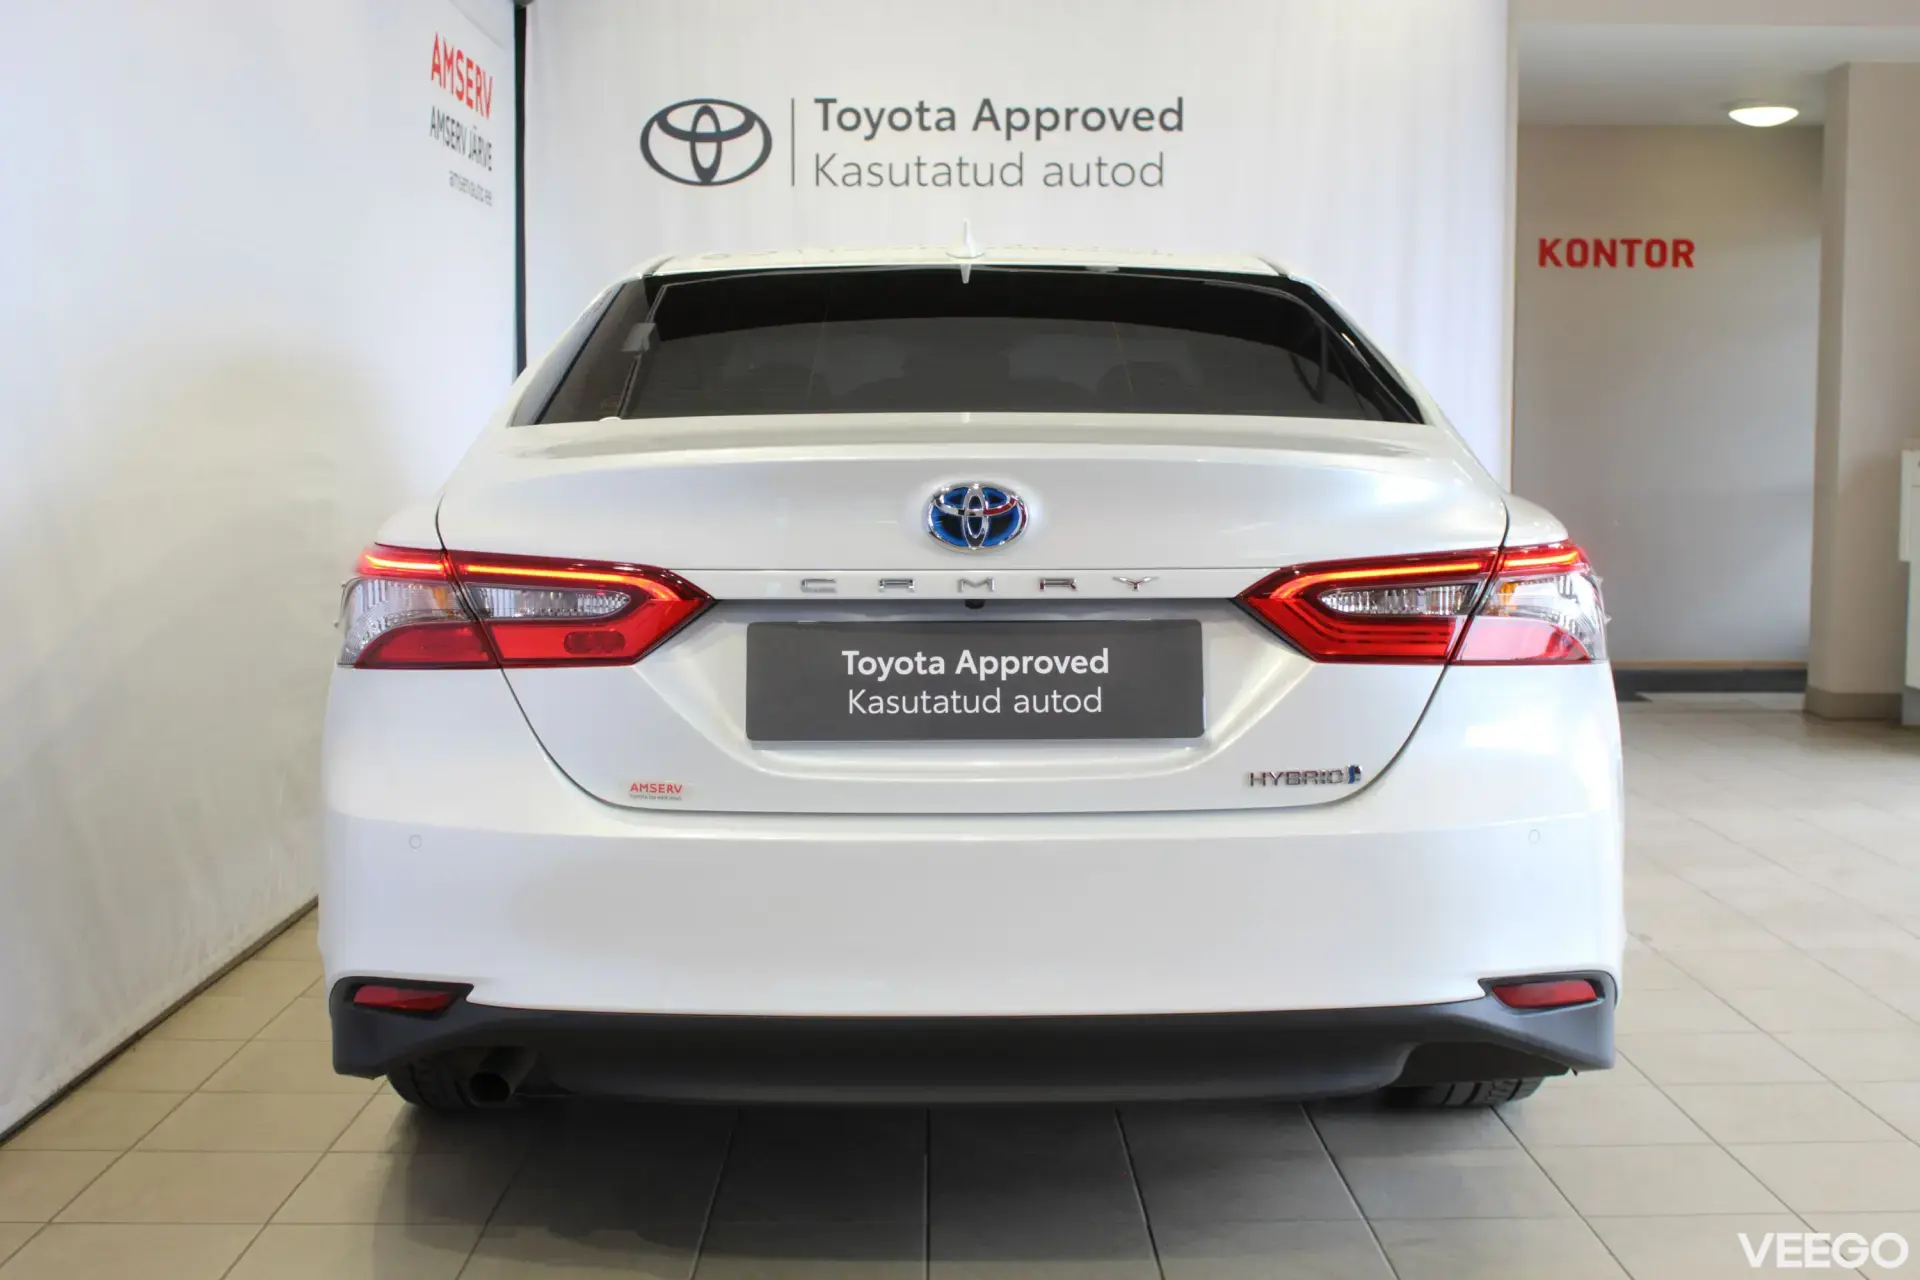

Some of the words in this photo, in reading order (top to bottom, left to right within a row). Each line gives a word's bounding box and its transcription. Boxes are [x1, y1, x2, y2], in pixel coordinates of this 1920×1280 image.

[431, 32, 493, 119] AMSERV
[430, 105, 467, 156] AMSERV
[814, 97, 955, 142] Toyota
[972, 96, 1184, 142] Approved
[815, 151, 1024, 188] Kasutatud
[1043, 151, 1164, 188] autod
[1538, 237, 1695, 269] KONTOR
[800, 576, 1159, 593] CAMRY
[841, 650, 946, 682] Toyota
[954, 647, 1109, 682] Approved
[848, 687, 1001, 715] Kasutatud
[1013, 686, 1103, 714] autod
[630, 782, 683, 794] AMSERV
[1250, 769, 1344, 786] HYBRID
